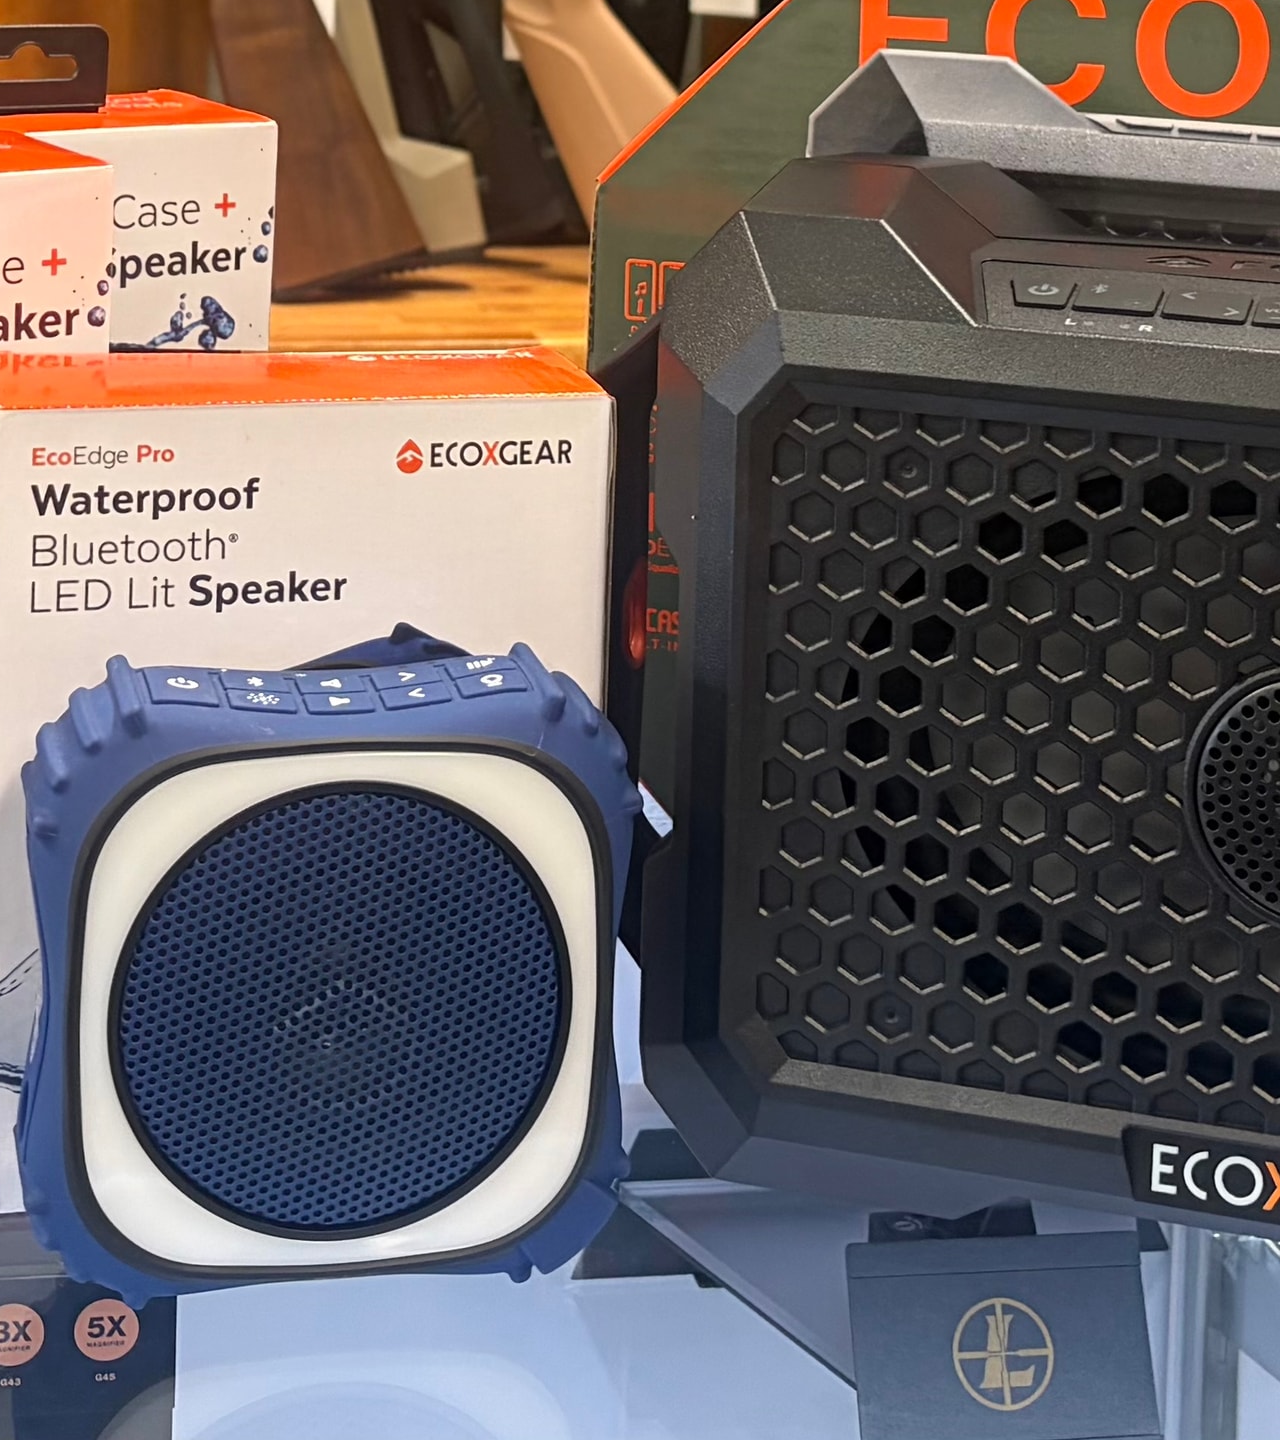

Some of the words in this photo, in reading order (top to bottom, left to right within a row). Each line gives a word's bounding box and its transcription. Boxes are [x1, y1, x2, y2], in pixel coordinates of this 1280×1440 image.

[111, 195, 202, 231] Case
[213, 193, 238, 217] +
[40, 248, 68, 278] +
[1137, 323, 1154, 333] R
[31, 445, 129, 468] EcoEdge
[136, 443, 175, 464] Pro
[429, 440, 573, 469] ECOXGEAR
[31, 477, 260, 520] Waterproof
[30, 576, 113, 614] LED
[126, 574, 176, 609] Lit
[188, 570, 348, 614] Speaker
[86, 1315, 128, 1339] 5X
